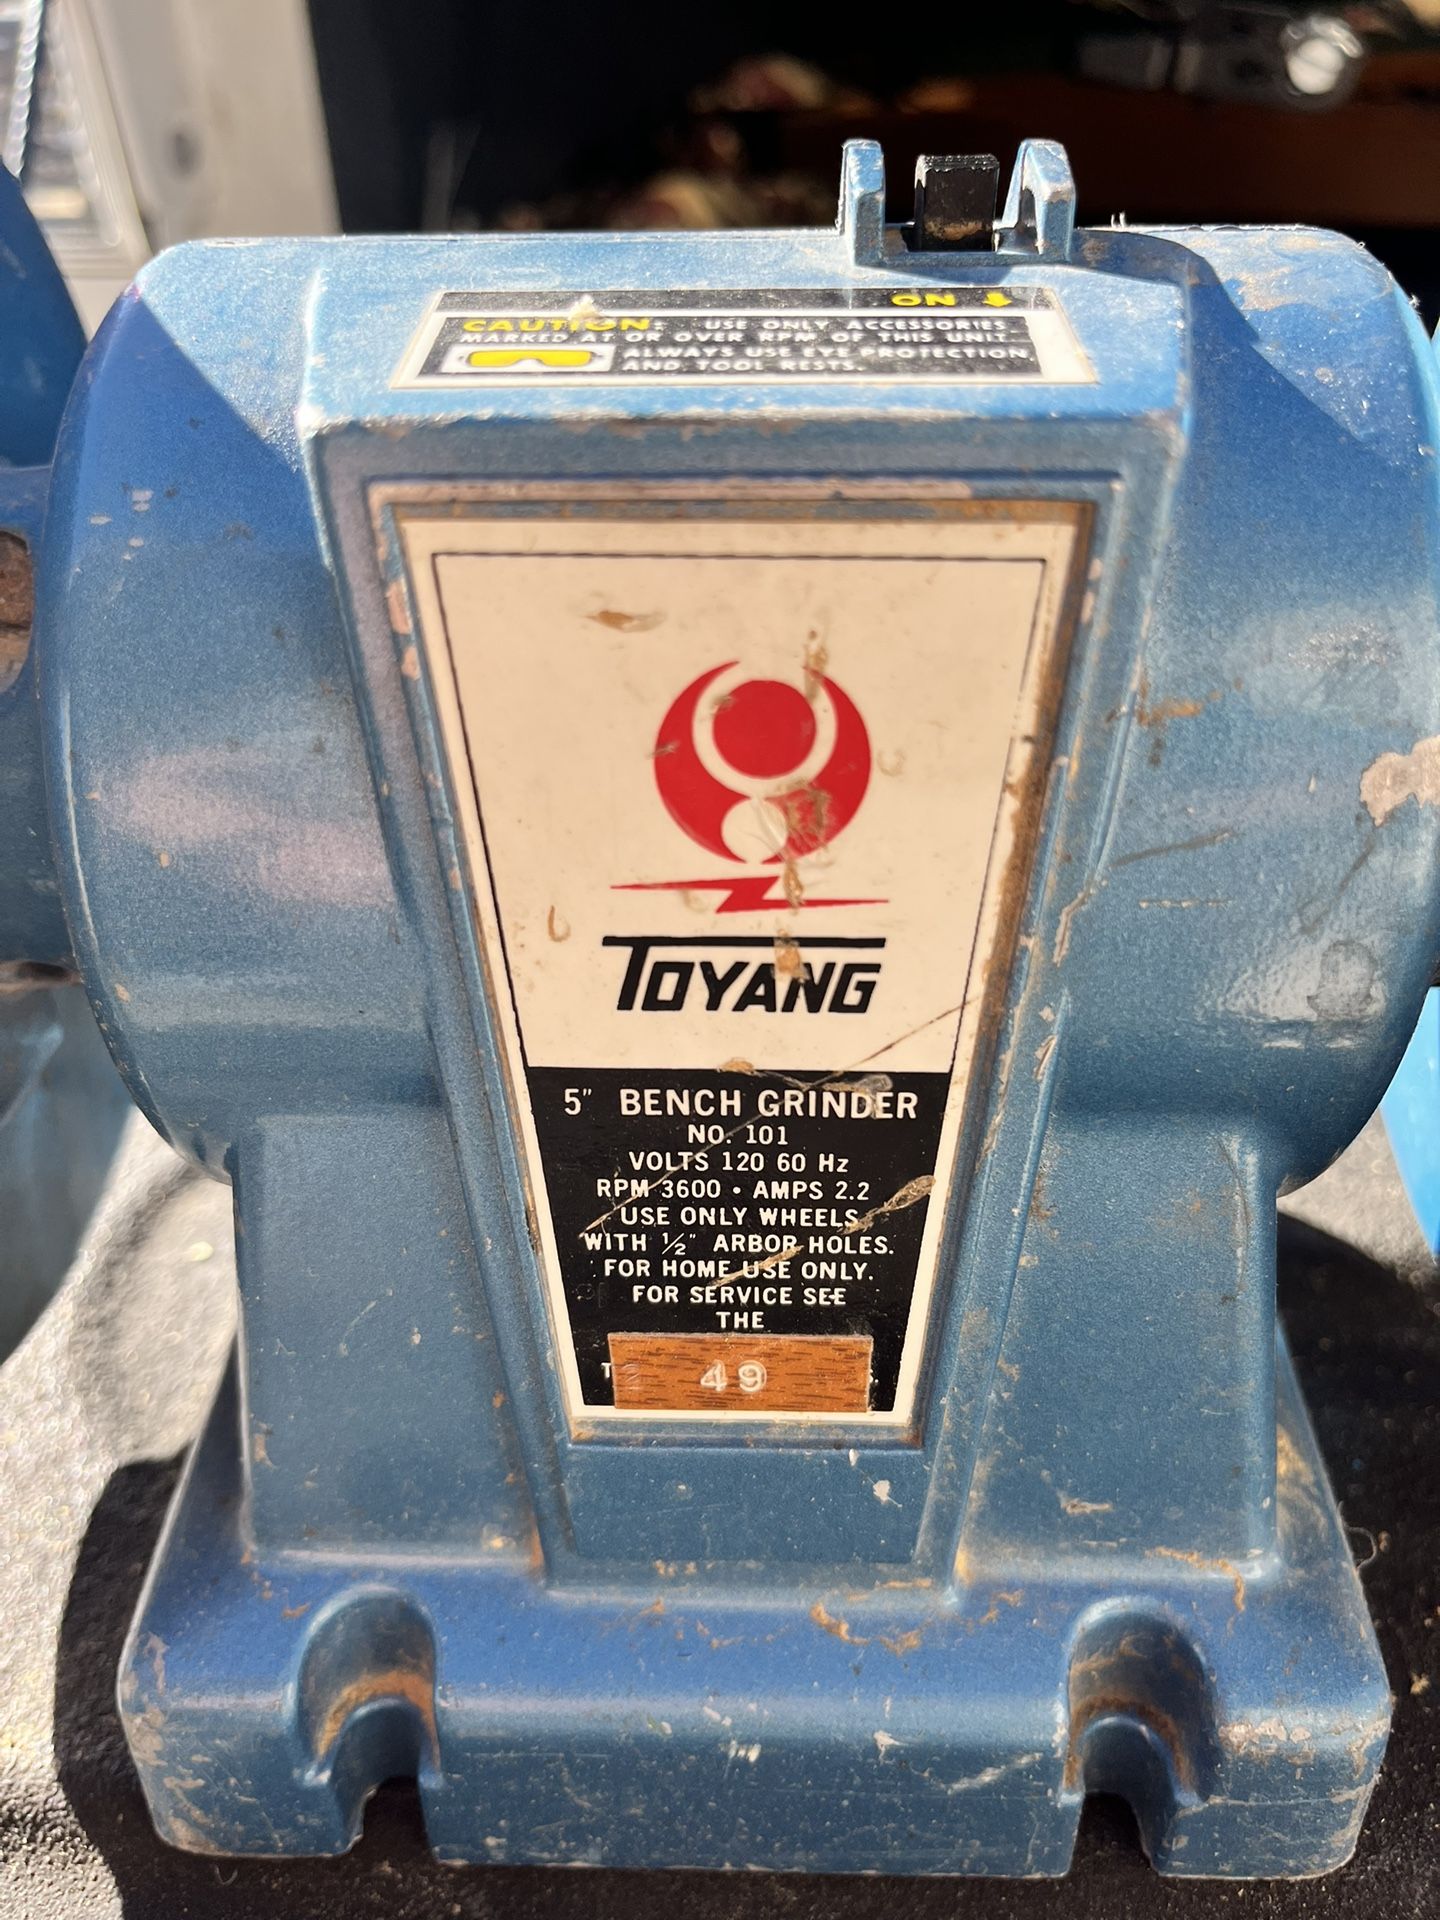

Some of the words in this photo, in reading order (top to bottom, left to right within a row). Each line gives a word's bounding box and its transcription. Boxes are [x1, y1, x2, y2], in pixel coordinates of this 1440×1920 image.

[891, 293, 956, 307] ON
[704, 321, 747, 331] USE
[762, 321, 830, 331] ONLY
[846, 321, 1006, 331] ACCESSORIES
[460, 332, 569, 343] MARKED
[580, 332, 616, 343] AT
[626, 332, 660, 342] OR
[674, 332, 745, 343] OVER
[759, 333, 817, 343] RPM
[831, 333, 864, 343] OF
[879, 333, 935, 343] THIS
[622, 346, 735, 359] ALWAYS
[747, 347, 792, 358] USE
[803, 347, 847, 358] EYE
[622, 360, 681, 371] AND
[696, 360, 766, 371] TOOL
[781, 360, 864, 371] RESTS.
[602, 936, 886, 1013] TOYANG
[564, 1088, 593, 1116] 5"
[619, 1088, 742, 1117] BENCH
[757, 1089, 919, 1120] GRINDER
[687, 1125, 732, 1145] NO.
[746, 1126, 788, 1146] 101
[628, 1151, 709, 1172] VOLTS
[722, 1152, 765, 1172] 120
[777, 1152, 806, 1173] 60
[818, 1153, 849, 1173] Hz
[597, 1178, 650, 1199] RPM
[661, 1179, 722, 1199] 3600
[752, 1180, 824, 1200] AMPS
[835, 1180, 871, 1201] 2.2
[620, 1206, 671, 1226] USE
[680, 1206, 748, 1226] ONLY
[759, 1207, 859, 1228] WHEELS
[584, 1232, 648, 1252] WITH
[712, 1233, 798, 1254] ARBOR
[808, 1234, 895, 1255] HOLES.
[604, 1258, 652, 1278] FOR
[662, 1258, 730, 1279] HOME
[742, 1259, 792, 1280] USE
[801, 1260, 875, 1281] ONLY.
[632, 1284, 680, 1305] FOR
[689, 1285, 793, 1306] SERVICE
[803, 1286, 847, 1306] SEE
[716, 1311, 765, 1330] THE
